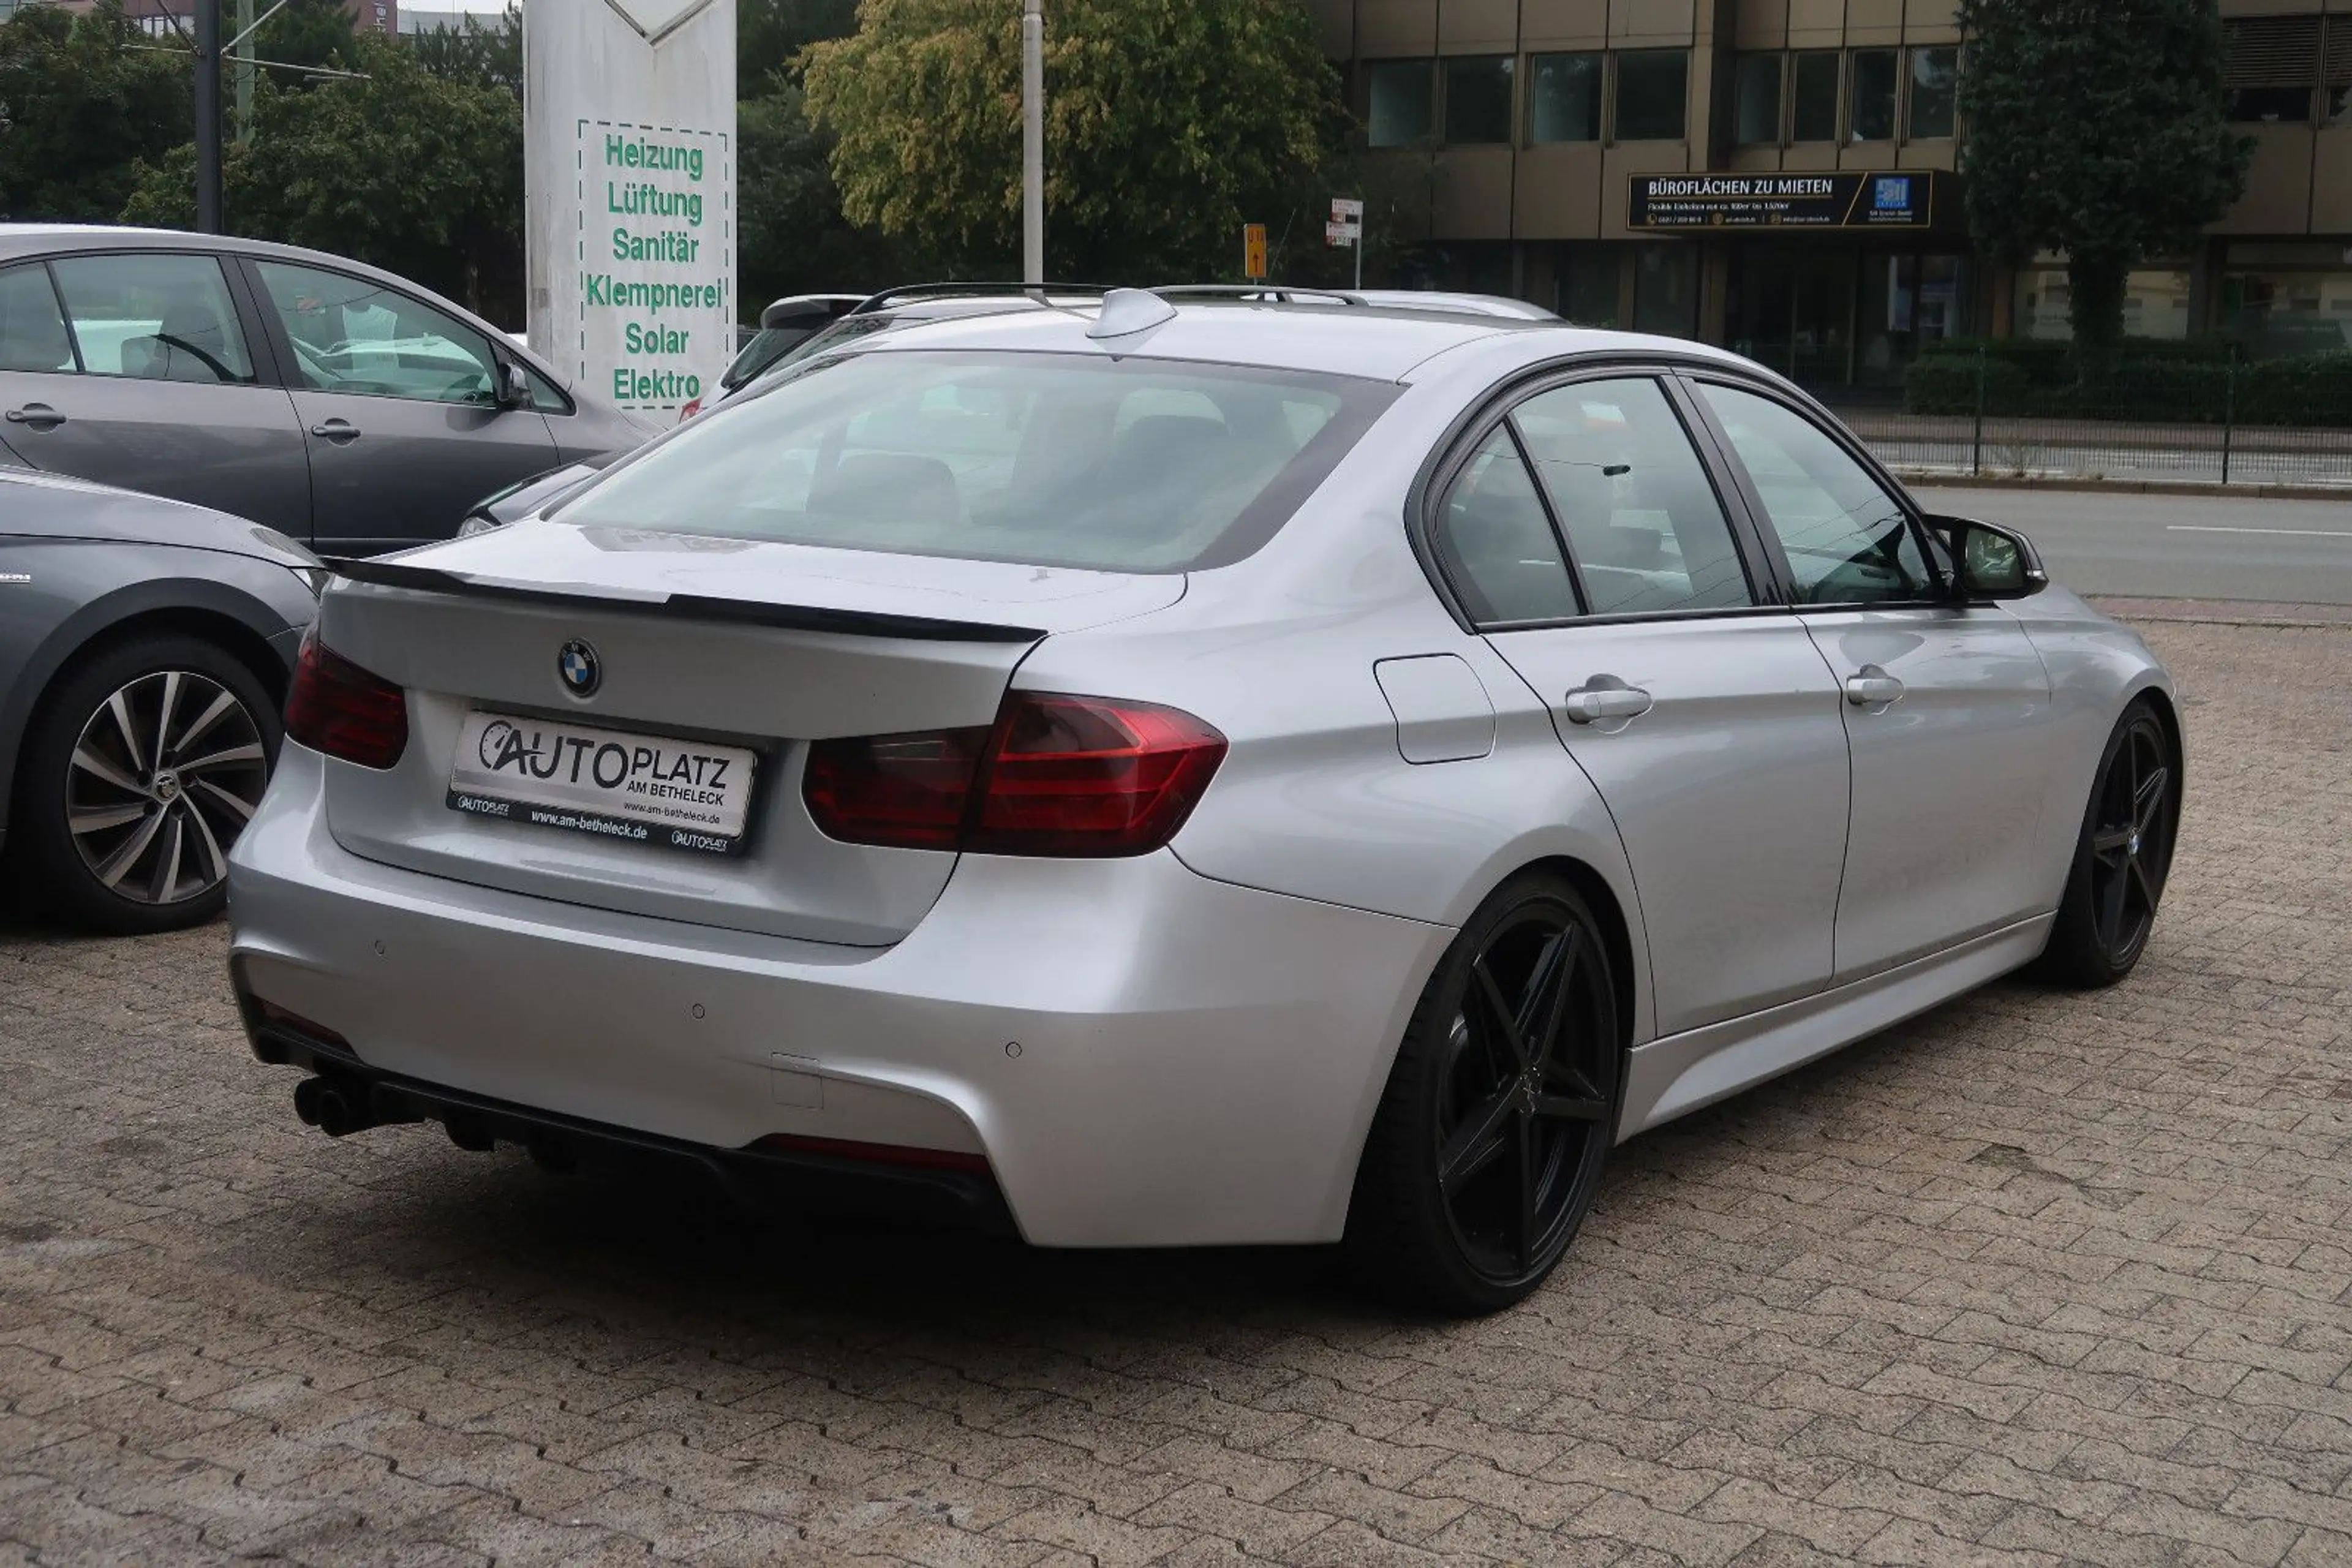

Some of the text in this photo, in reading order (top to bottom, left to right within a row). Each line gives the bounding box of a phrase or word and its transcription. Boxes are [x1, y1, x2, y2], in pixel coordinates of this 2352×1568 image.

[606, 134, 703, 181] Heizung
[1648, 178, 1833, 195] BÜROFLÄCHEN ZU MIETEN
[608, 181, 703, 226] Lüftung
[613, 228, 699, 263] Sanitär
[587, 274, 722, 314] Klempnerei
[625, 323, 689, 355] Solar
[614, 369, 700, 399] Elektro
[626, 780, 723, 806] AM BETHELECK
[531, 809, 648, 839] www.am-betheleck.de
[624, 802, 720, 824] www.am-betheleck.de
